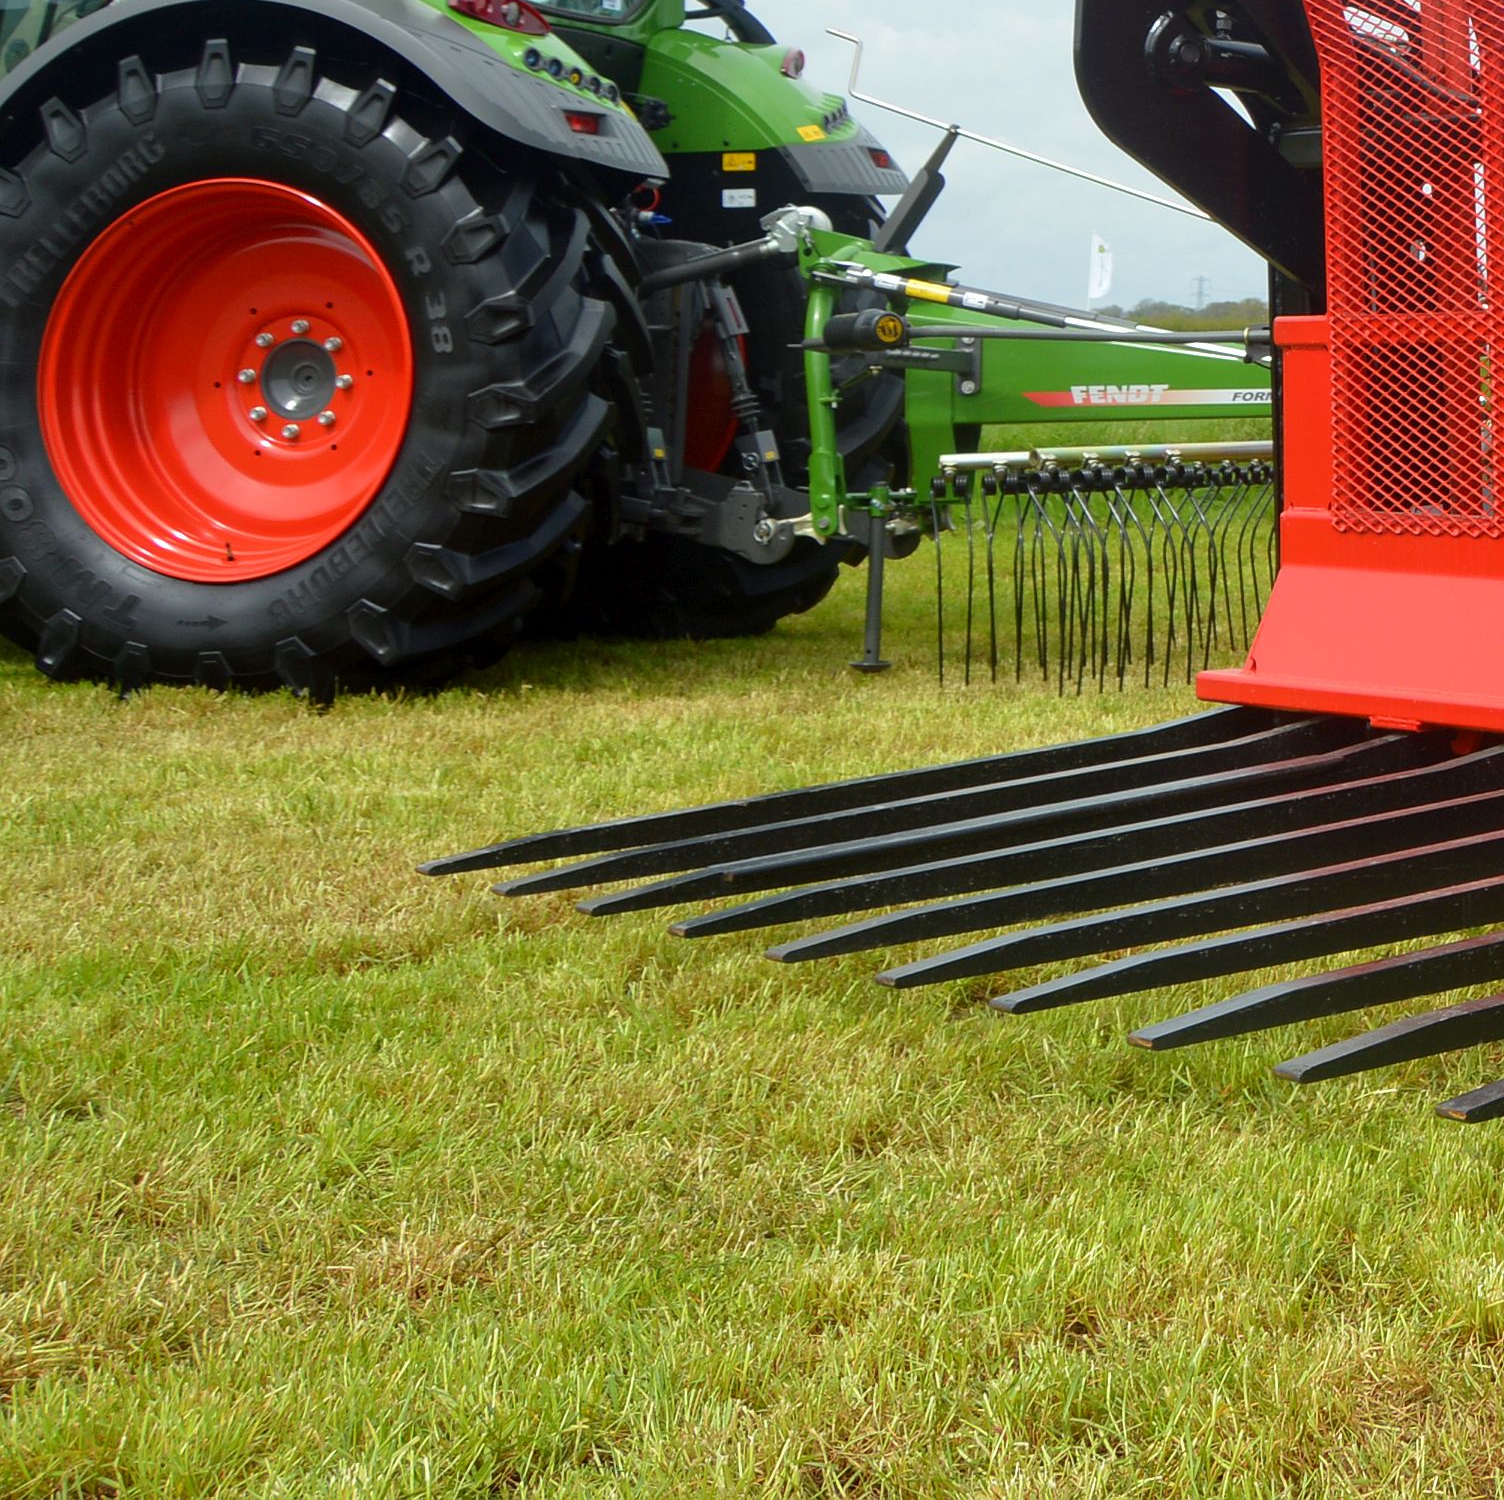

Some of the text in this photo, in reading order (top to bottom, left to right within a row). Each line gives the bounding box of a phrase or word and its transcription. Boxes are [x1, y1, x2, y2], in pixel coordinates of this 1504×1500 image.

[405, 243, 432, 277] R
[424, 290, 454, 354] 38
[1070, 383, 1169, 404] FENDT
